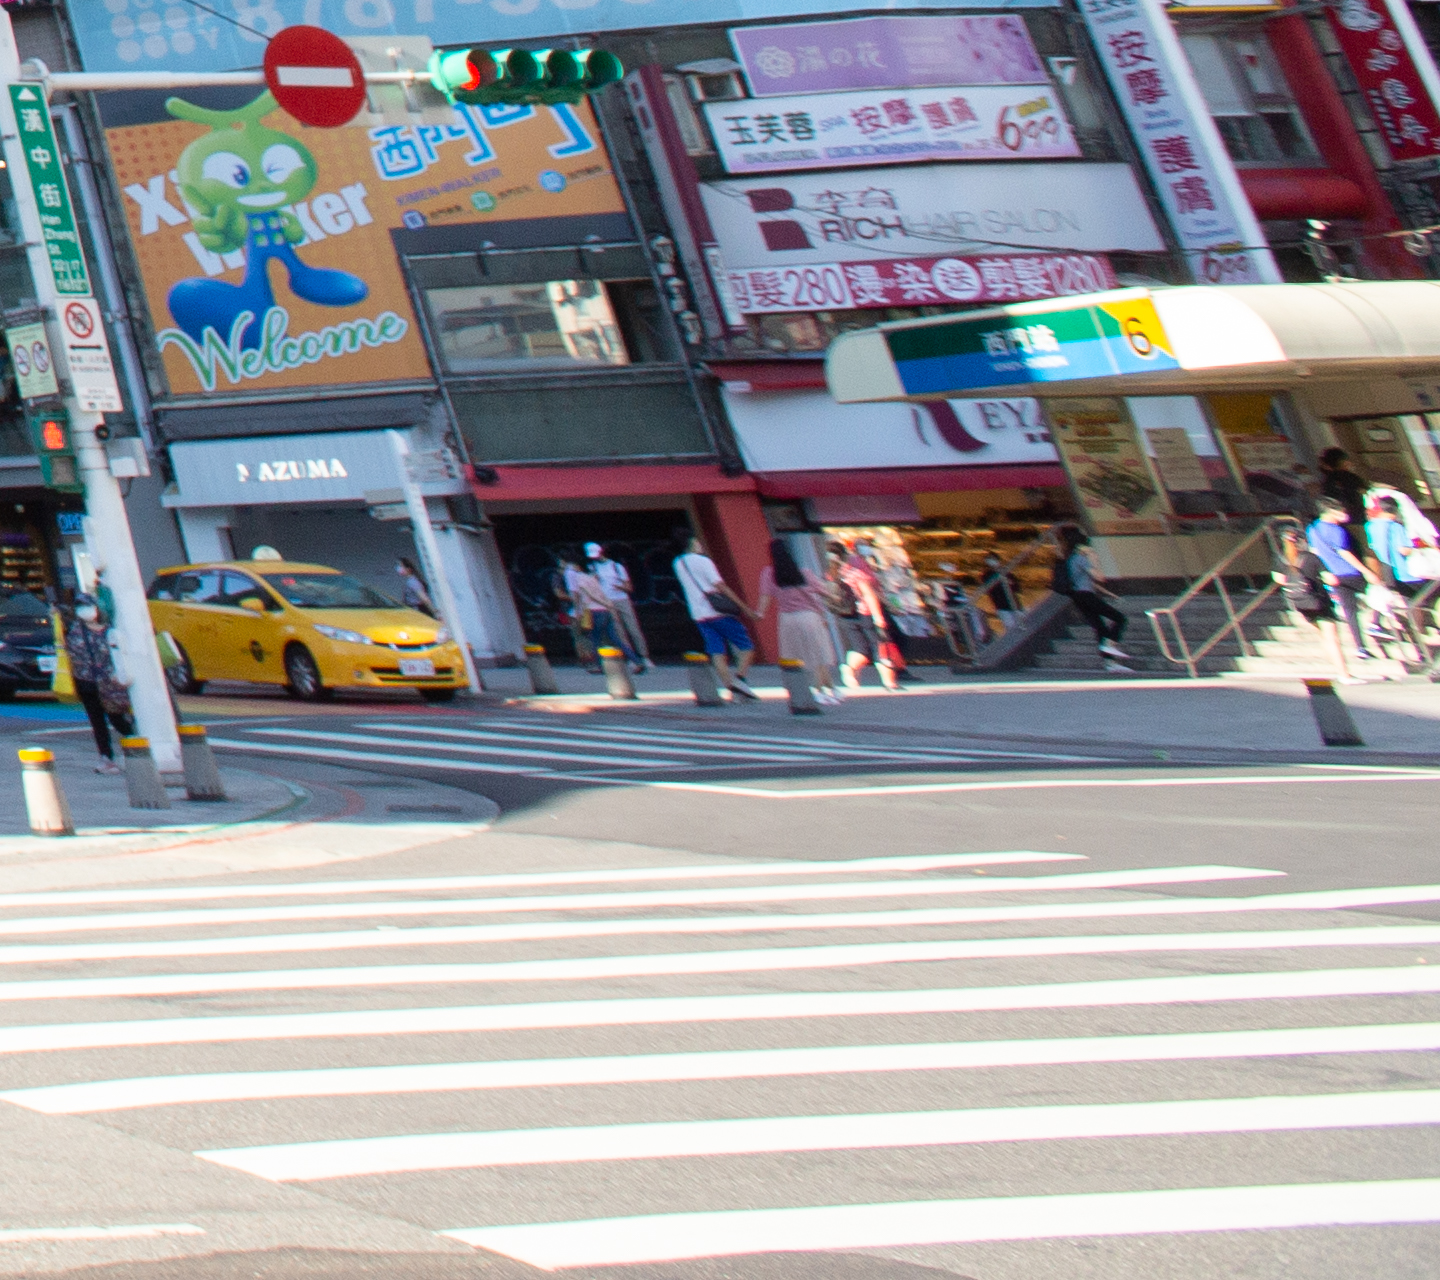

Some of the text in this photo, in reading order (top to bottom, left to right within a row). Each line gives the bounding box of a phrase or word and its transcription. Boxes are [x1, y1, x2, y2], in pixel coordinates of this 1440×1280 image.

[20, 108, 62, 208] 漢中街
[159, 306, 408, 391] Welcome
[1125, 317, 1151, 359] 6
